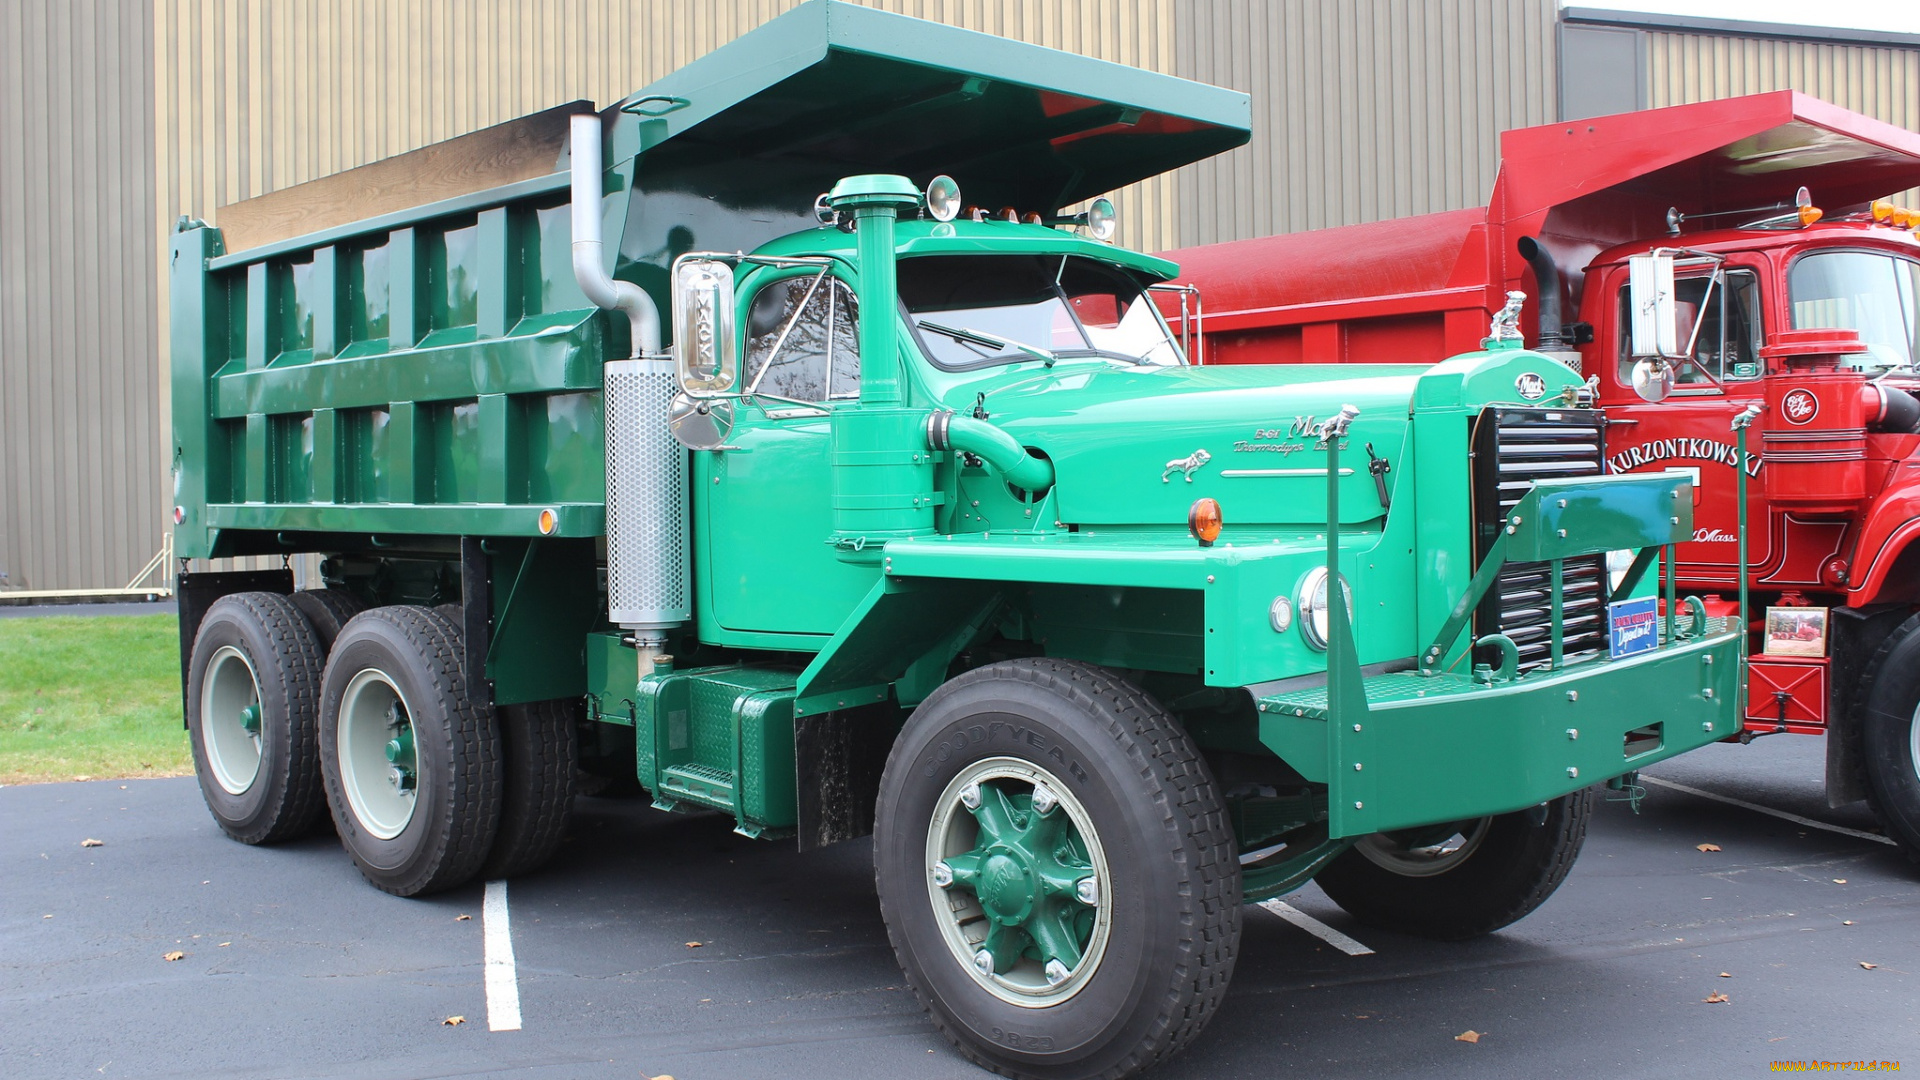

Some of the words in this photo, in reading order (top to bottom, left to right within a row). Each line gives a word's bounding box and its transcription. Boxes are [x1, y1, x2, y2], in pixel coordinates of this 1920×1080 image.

[696, 293, 712, 361] MACK
[1518, 376, 1543, 393] Mack
[1787, 394, 1806, 410] Big
[1788, 400, 1812, 418] Joe
[1233, 440, 1304, 458] Thermodyne
[1606, 437, 1764, 478] KURZONTKOWSKI
[1697, 527, 1738, 543] Mass.
[924, 720, 1089, 786] GOODYEAR
